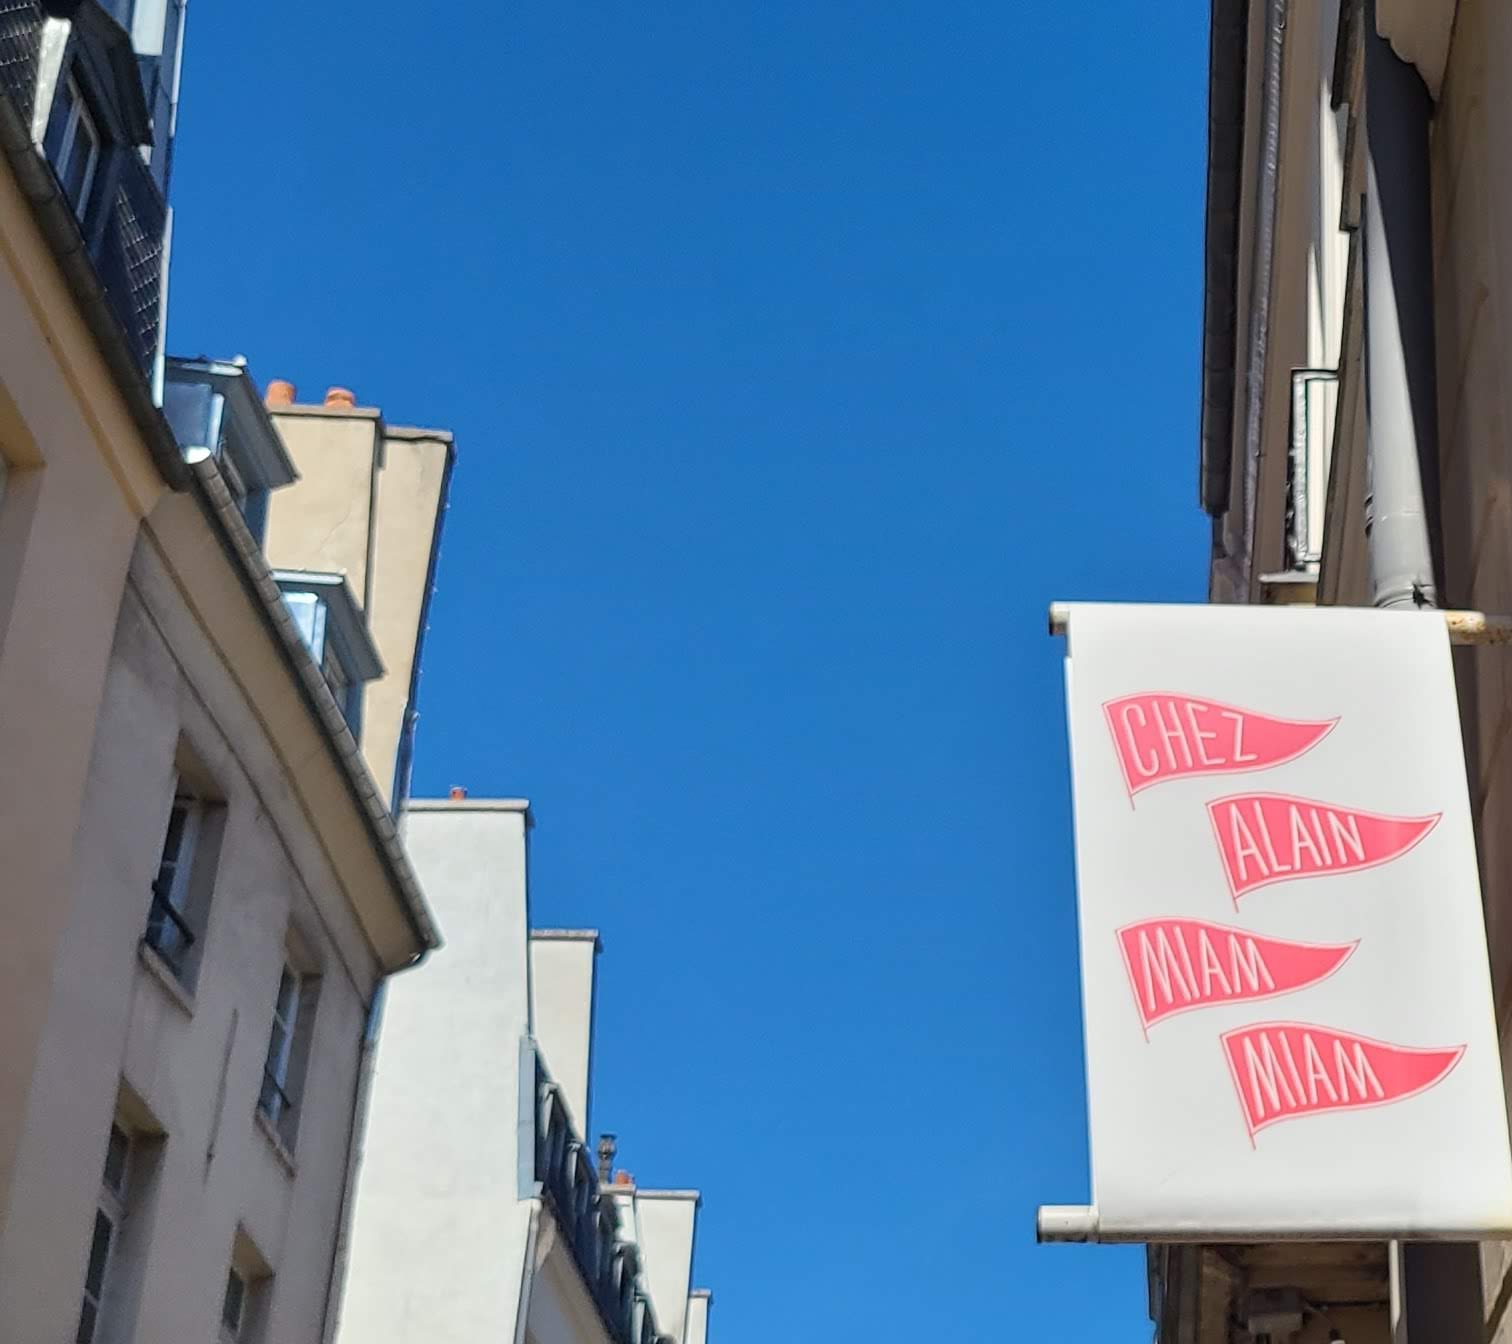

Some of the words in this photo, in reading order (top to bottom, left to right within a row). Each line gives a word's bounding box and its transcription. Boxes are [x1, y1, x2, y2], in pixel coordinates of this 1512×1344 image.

[1120, 701, 1257, 777] CHEZ
[1227, 801, 1365, 880] ALAIN
[1139, 926, 1275, 1012] MIAM
[1242, 1029, 1385, 1118] MIAM
